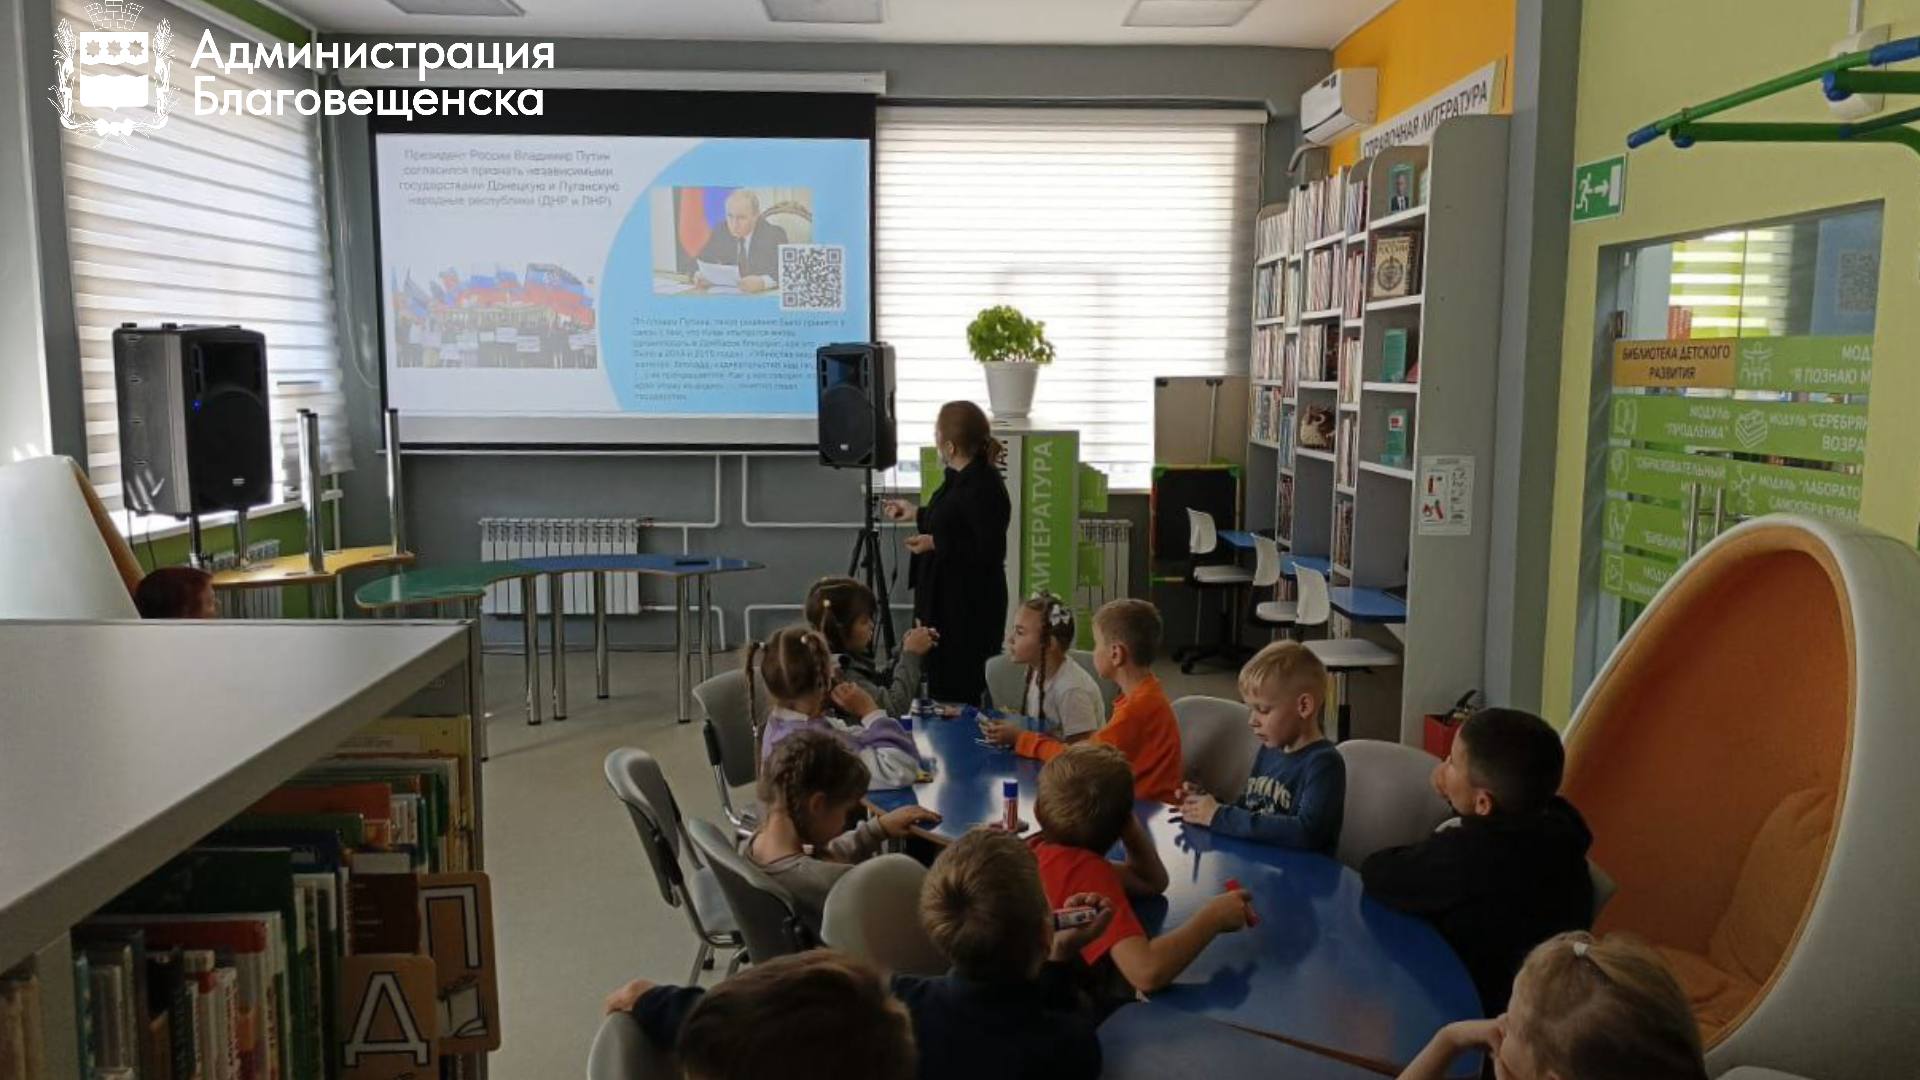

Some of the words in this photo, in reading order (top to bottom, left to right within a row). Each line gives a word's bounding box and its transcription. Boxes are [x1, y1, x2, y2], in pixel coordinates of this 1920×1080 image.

[1421, 80, 1488, 134] ЛИТЕРАТУРА
[404, 150, 467, 163] Президент
[470, 150, 511, 162] России
[514, 150, 573, 163] Владимир
[576, 150, 610, 163] Путин
[403, 166, 468, 177] согласился
[472, 166, 524, 178] признать
[526, 166, 613, 178] независимыми
[399, 181, 484, 193] государствами
[487, 180, 545, 193] Донецкую
[559, 180, 620, 193] Луганскую
[1622, 347, 1678, 360] БИБЛИОТЕКА
[1680, 345, 1731, 360] ДЕТСКОГО
[1648, 366, 1696, 379] РАЗВИТИЯ
[1805, 368, 1857, 385] ПОЗНАЮ
[1769, 413, 1807, 427] МОДУЛЬ
[1032, 440, 1054, 594] ЛИТЕРАТУРА
[342, 970, 430, 1068] Д
